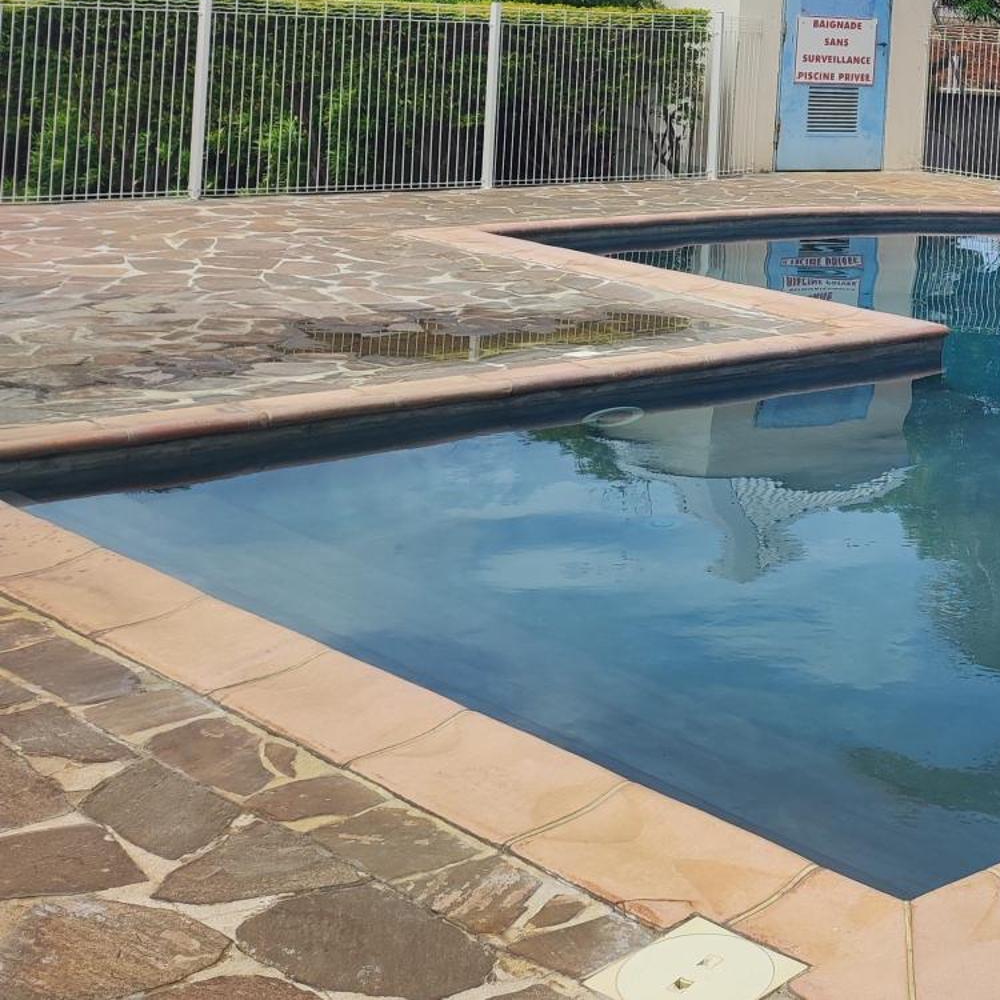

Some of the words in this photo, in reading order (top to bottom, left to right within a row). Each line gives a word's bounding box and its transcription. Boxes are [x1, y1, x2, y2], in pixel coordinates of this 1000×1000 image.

[812, 19, 863, 30] BAIGNADE
[824, 38, 849, 47] SANS
[802, 54, 871, 65] SURVEILLANCE
[797, 71, 835, 81] PISCINE
[838, 73, 871, 82] PRIVEE
